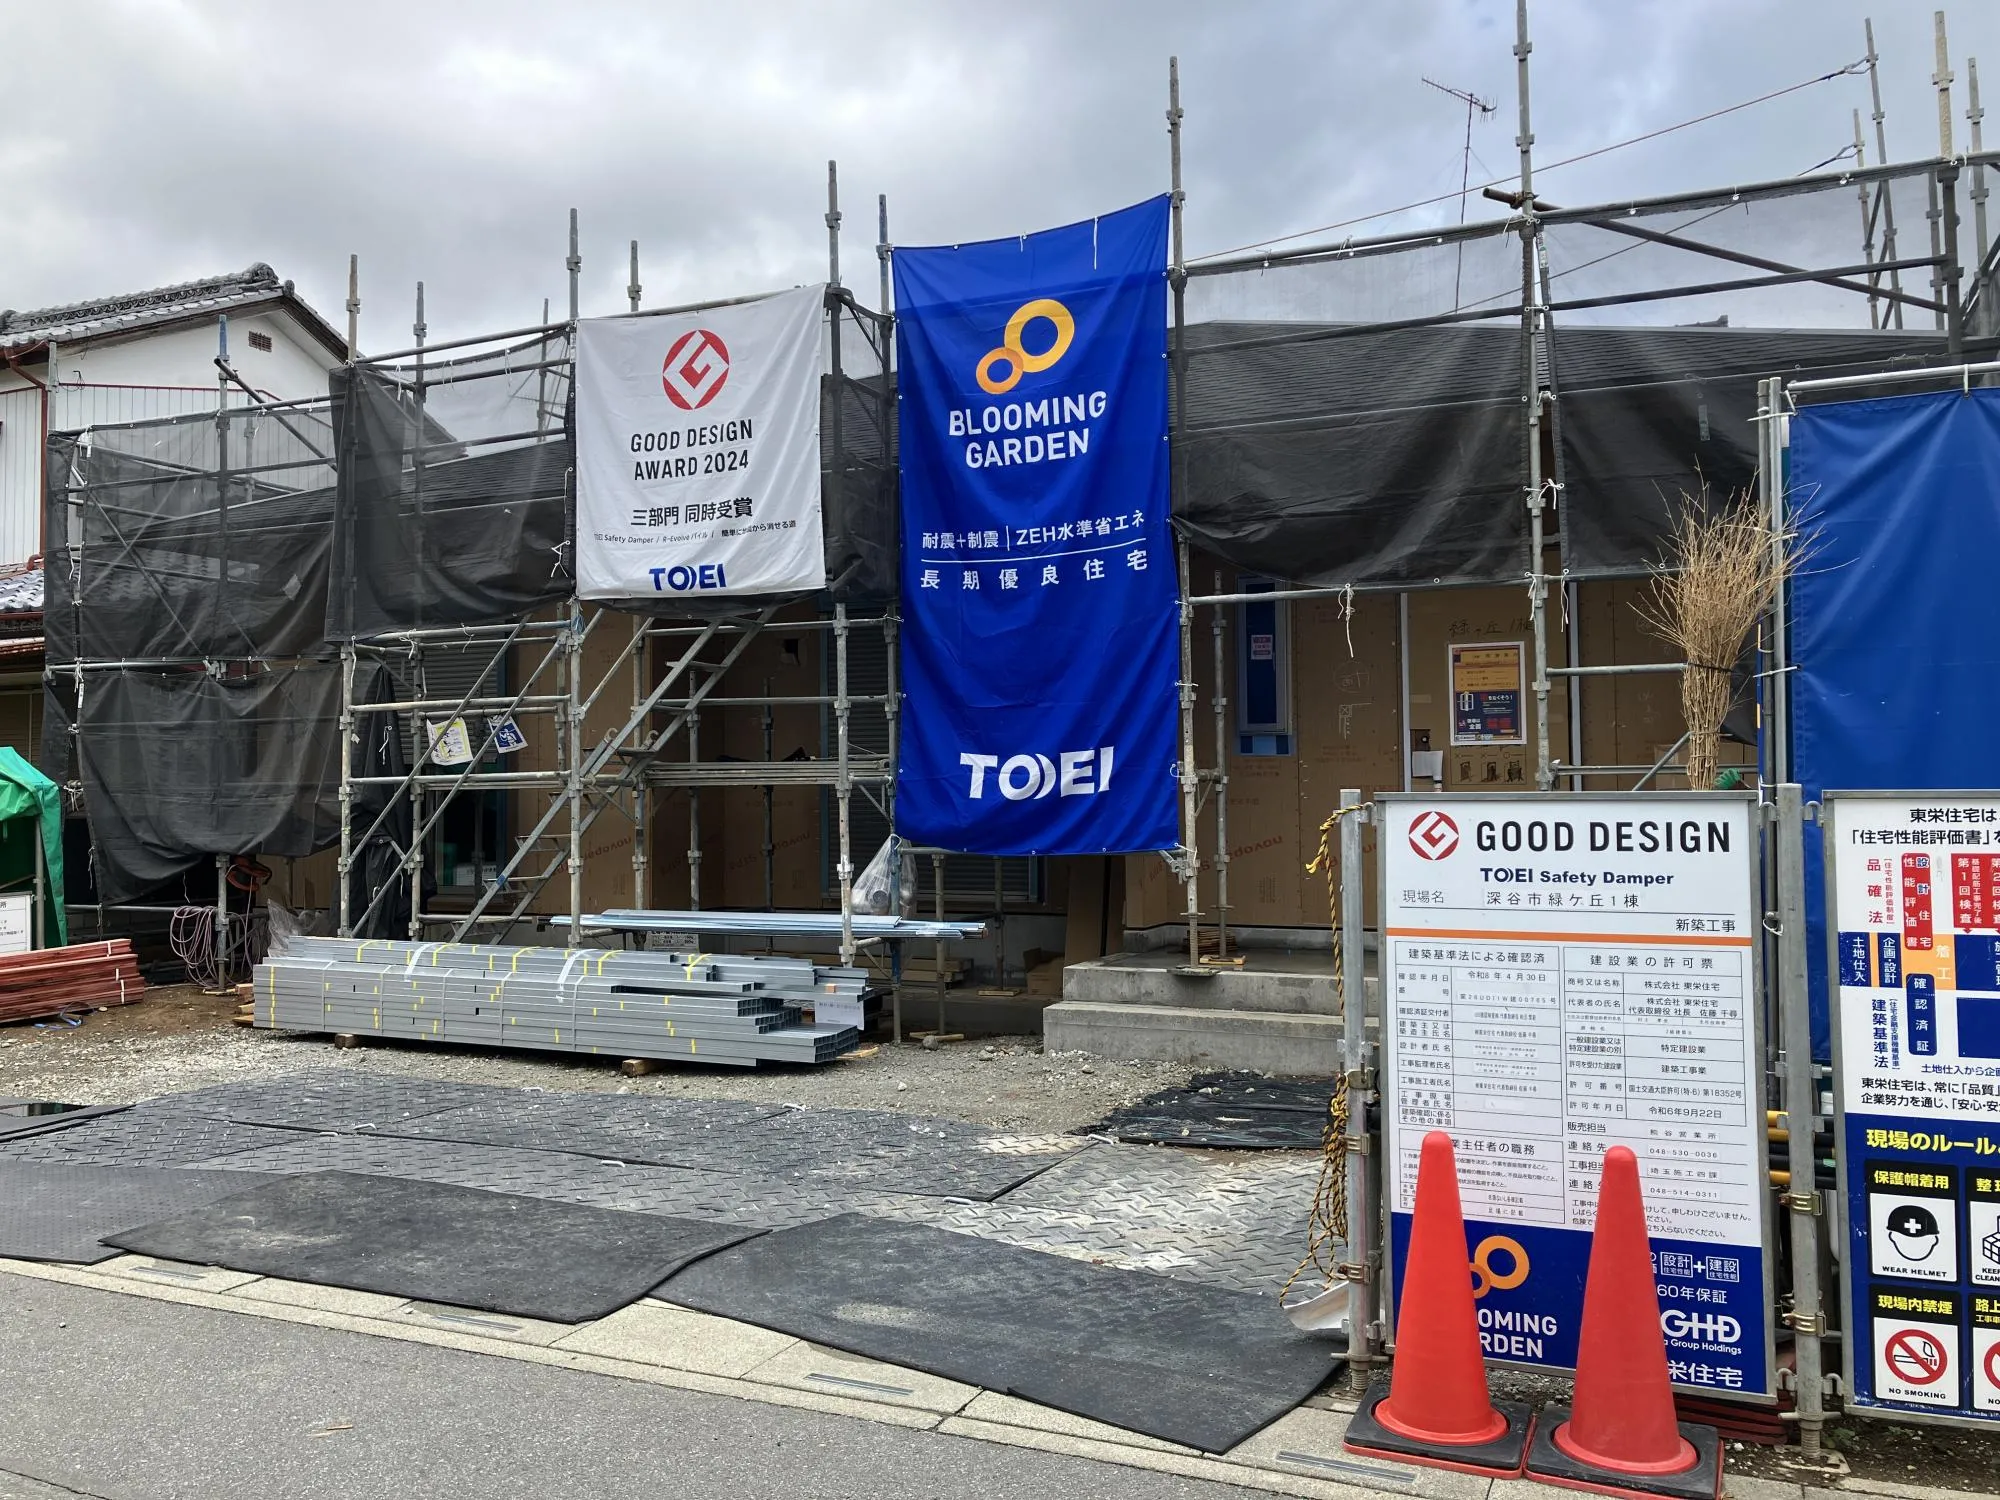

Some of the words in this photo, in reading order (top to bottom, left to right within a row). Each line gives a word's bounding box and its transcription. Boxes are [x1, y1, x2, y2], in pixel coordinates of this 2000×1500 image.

[949, 391, 1107, 436] BLOOMING
[631, 431, 680, 453] GOOD
[687, 419, 752, 448] DESIGN
[966, 428, 1089, 469] GARDEN
[634, 456, 698, 481] AWARD
[704, 450, 749, 473] 2024
[631, 506, 679, 527] 三部門
[685, 497, 753, 524] 同時受賞
[1016, 510, 1145, 545] ZEH水準省エネ
[604, 534, 626, 544] Safety
[628, 536, 653, 544] Damper
[649, 564, 727, 591] TOEI
[920, 549, 1148, 590] 長期優良住宅
[960, 745, 1115, 801] TOEI
[1476, 820, 1575, 852] GOOD
[1590, 822, 1730, 853] DESIGN
[1480, 867, 1533, 884] TOEI
[1540, 870, 1596, 887] Safety
[1603, 872, 1674, 887] Damper
[1403, 890, 1445, 904] 現場名
[1867, 859, 1883, 924] 品確法
[1676, 918, 1736, 933] 新築工事
[1408, 948, 1545, 964] 建築基準法による確認済
[1590, 955, 1713, 969] 建設業の許可票
[1852, 936, 1866, 982] 土地仕入
[1644, 981, 1680, 990] 株式会社
[1684, 982, 1720, 992] 東栄住宅
[1568, 999, 1621, 1008] 代表者の氏名
[1914, 978, 1929, 1052] 確認済証
[1872, 999, 1888, 1068] 建築基準法
[1661, 1044, 1706, 1053] 特定建設業
[1662, 1065, 1707, 1074] 建築工事業
[1570, 1081, 1622, 1091] 許可番号
[1570, 1102, 1623, 1111] 許可年月日
[1861, 1093, 2000, 1112] 企業努力を通じ、「安心・安
[1402, 1117, 1451, 1126] その他の事項
[1568, 1122, 1606, 1132] 販売担当
[1452, 1139, 1535, 1155] 業主任者の職務
[1568, 1141, 1607, 1152] 連絡先
[1866, 1129, 2000, 1155] 現場のルール
[1569, 1179, 1600, 1190] 連絡
[1874, 1170, 1949, 1190] 保護帽着用
[1664, 1254, 1690, 1268] 設計
[1710, 1259, 1737, 1273] 建設
[1882, 1266, 1908, 1274] WEAR
[1911, 1268, 1947, 1277] HELMET
[1657, 1284, 1727, 1304] 60年保証
[1878, 1295, 1953, 1315] 現場内禁煙
[1478, 1308, 1557, 1336] OMING
[1480, 1332, 1543, 1359] RDEN
[1671, 1341, 1699, 1350] Group
[1702, 1343, 1742, 1355] Holdings
[1668, 1360, 1743, 1388] 栄住宅
[1904, 1389, 1946, 1400] SMOKING
